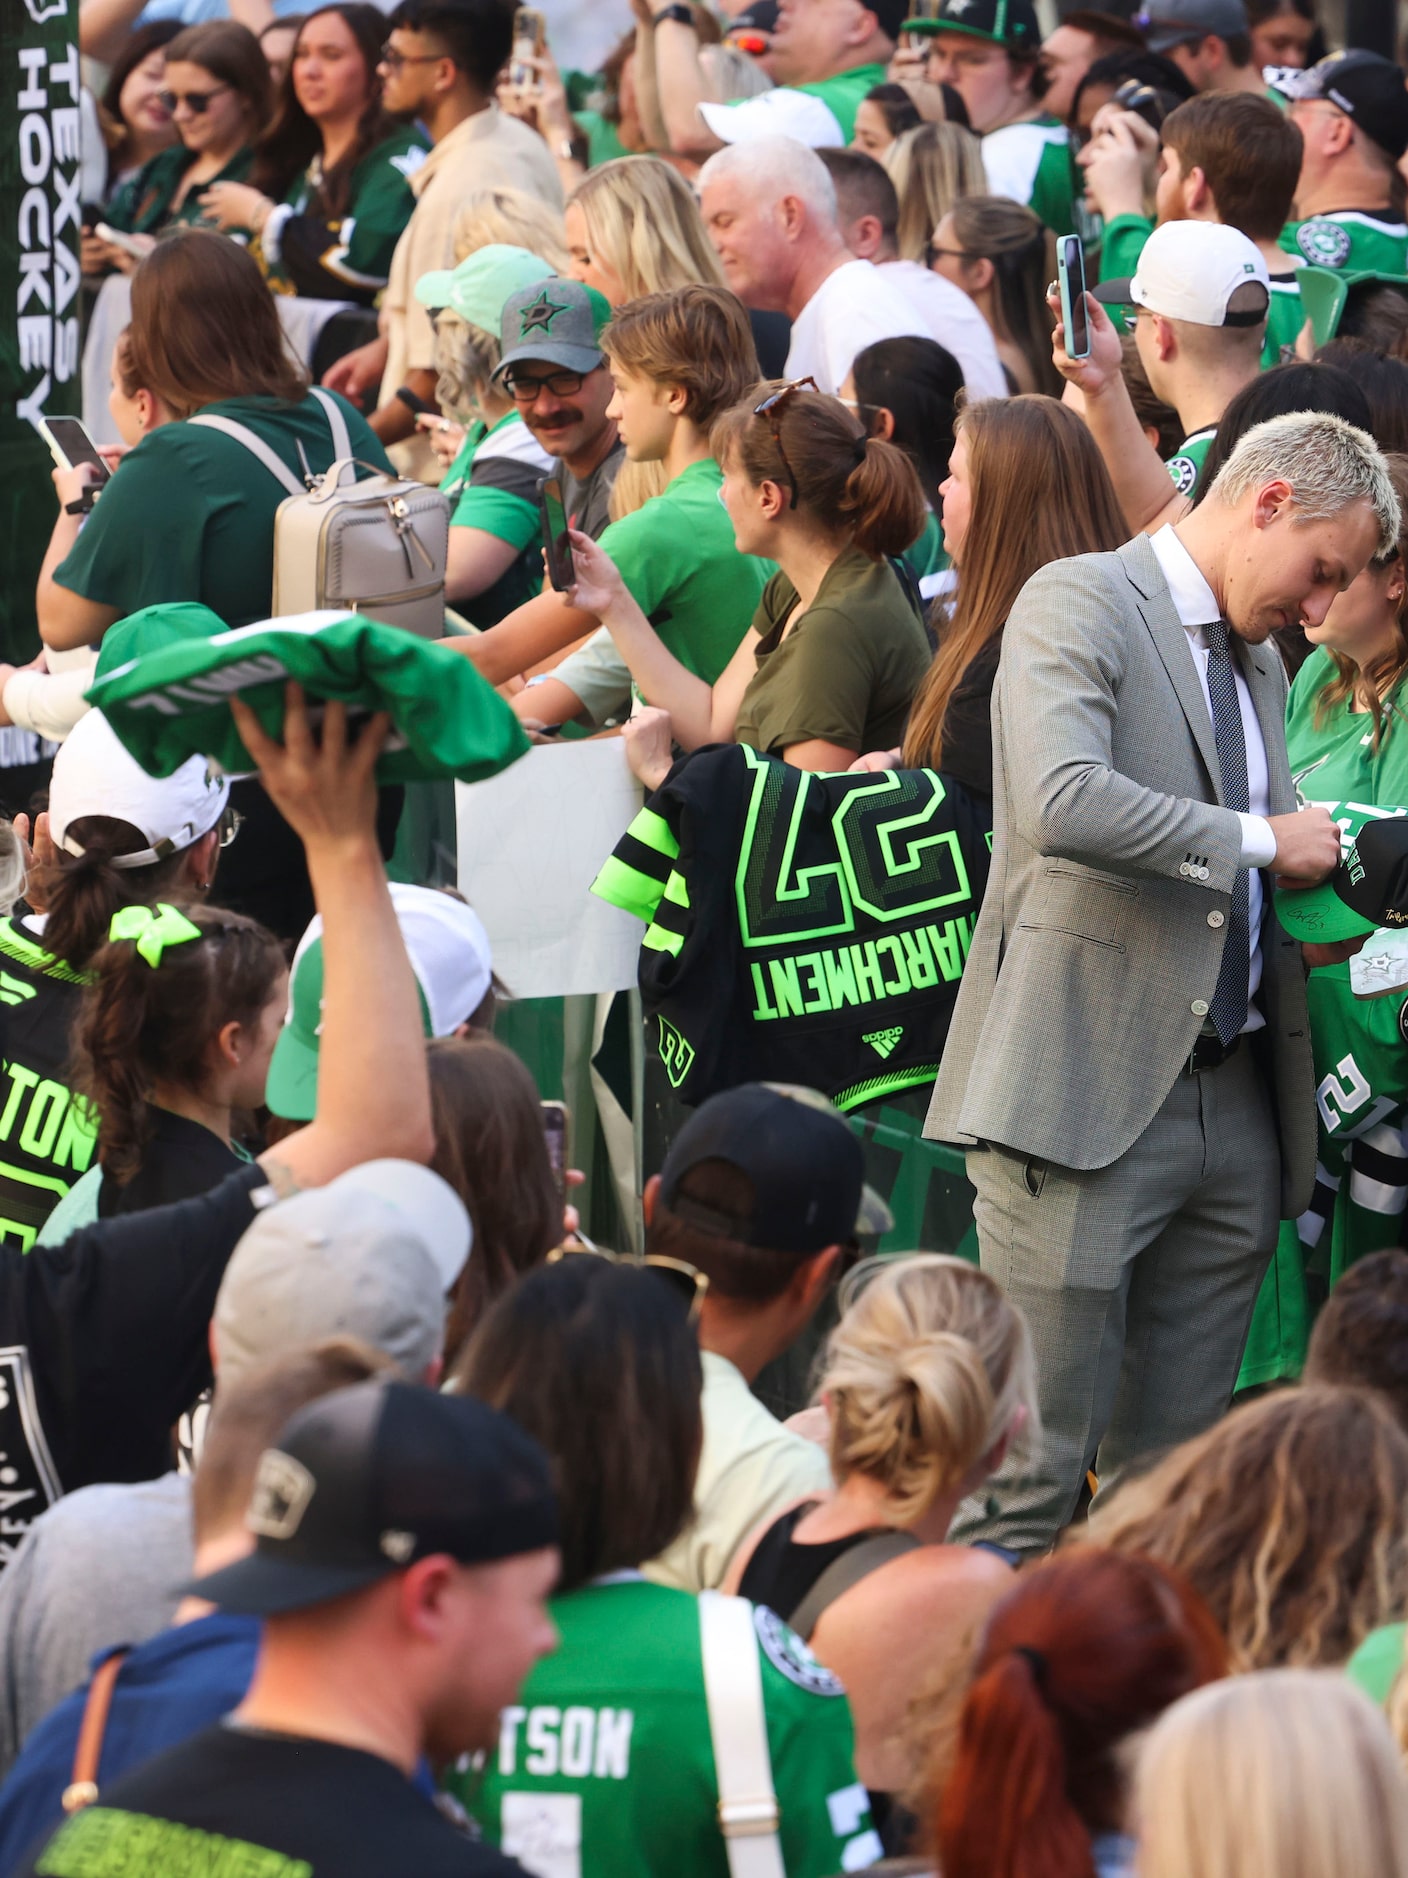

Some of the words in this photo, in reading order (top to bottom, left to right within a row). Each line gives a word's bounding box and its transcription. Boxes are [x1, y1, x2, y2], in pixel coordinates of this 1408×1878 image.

[16, 47, 53, 440] HOCKEY
[49, 42, 82, 384] TEXAS
[861, 1025, 904, 1044] adidas
[0, 1059, 103, 1174] TON
[457, 1704, 635, 1781] TSON
